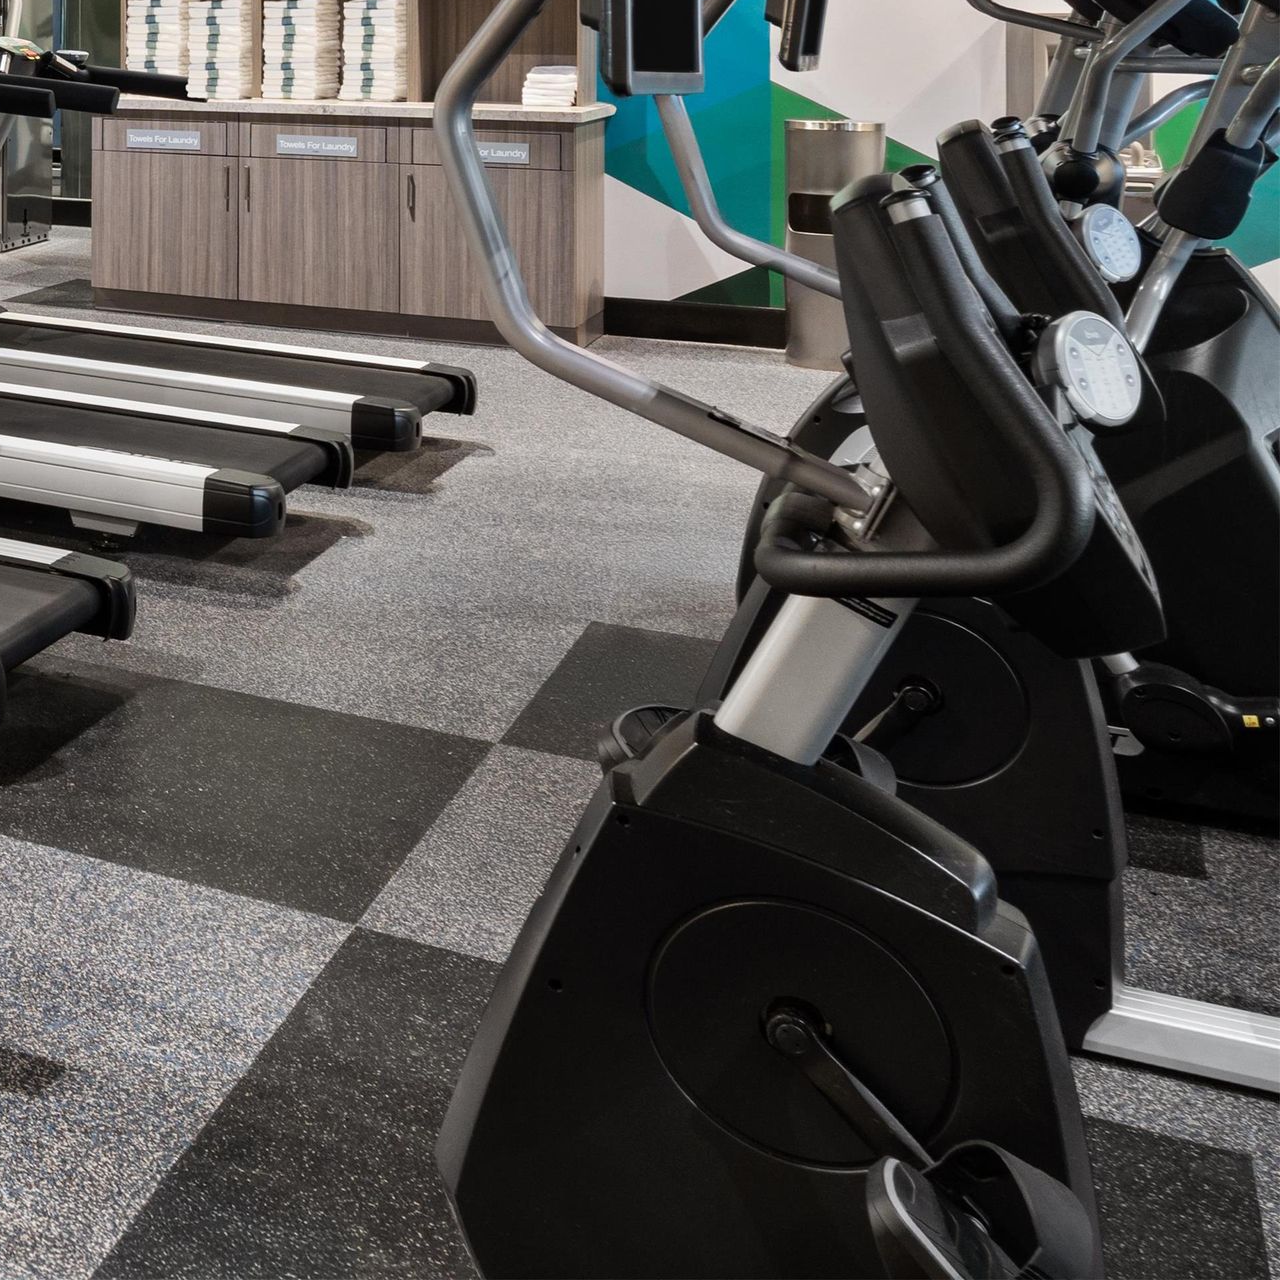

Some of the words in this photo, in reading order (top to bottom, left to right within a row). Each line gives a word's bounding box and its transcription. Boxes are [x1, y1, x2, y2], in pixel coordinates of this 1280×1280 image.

[129, 134, 153, 142] Towels
[154, 135, 167, 143] For
[168, 136, 198, 145] Laundry
[280, 140, 306, 149] Towels
[307, 141, 320, 149] For
[322, 142, 355, 153] Laundry
[478, 147, 489, 156] or
[491, 148, 527, 159] Laundry
